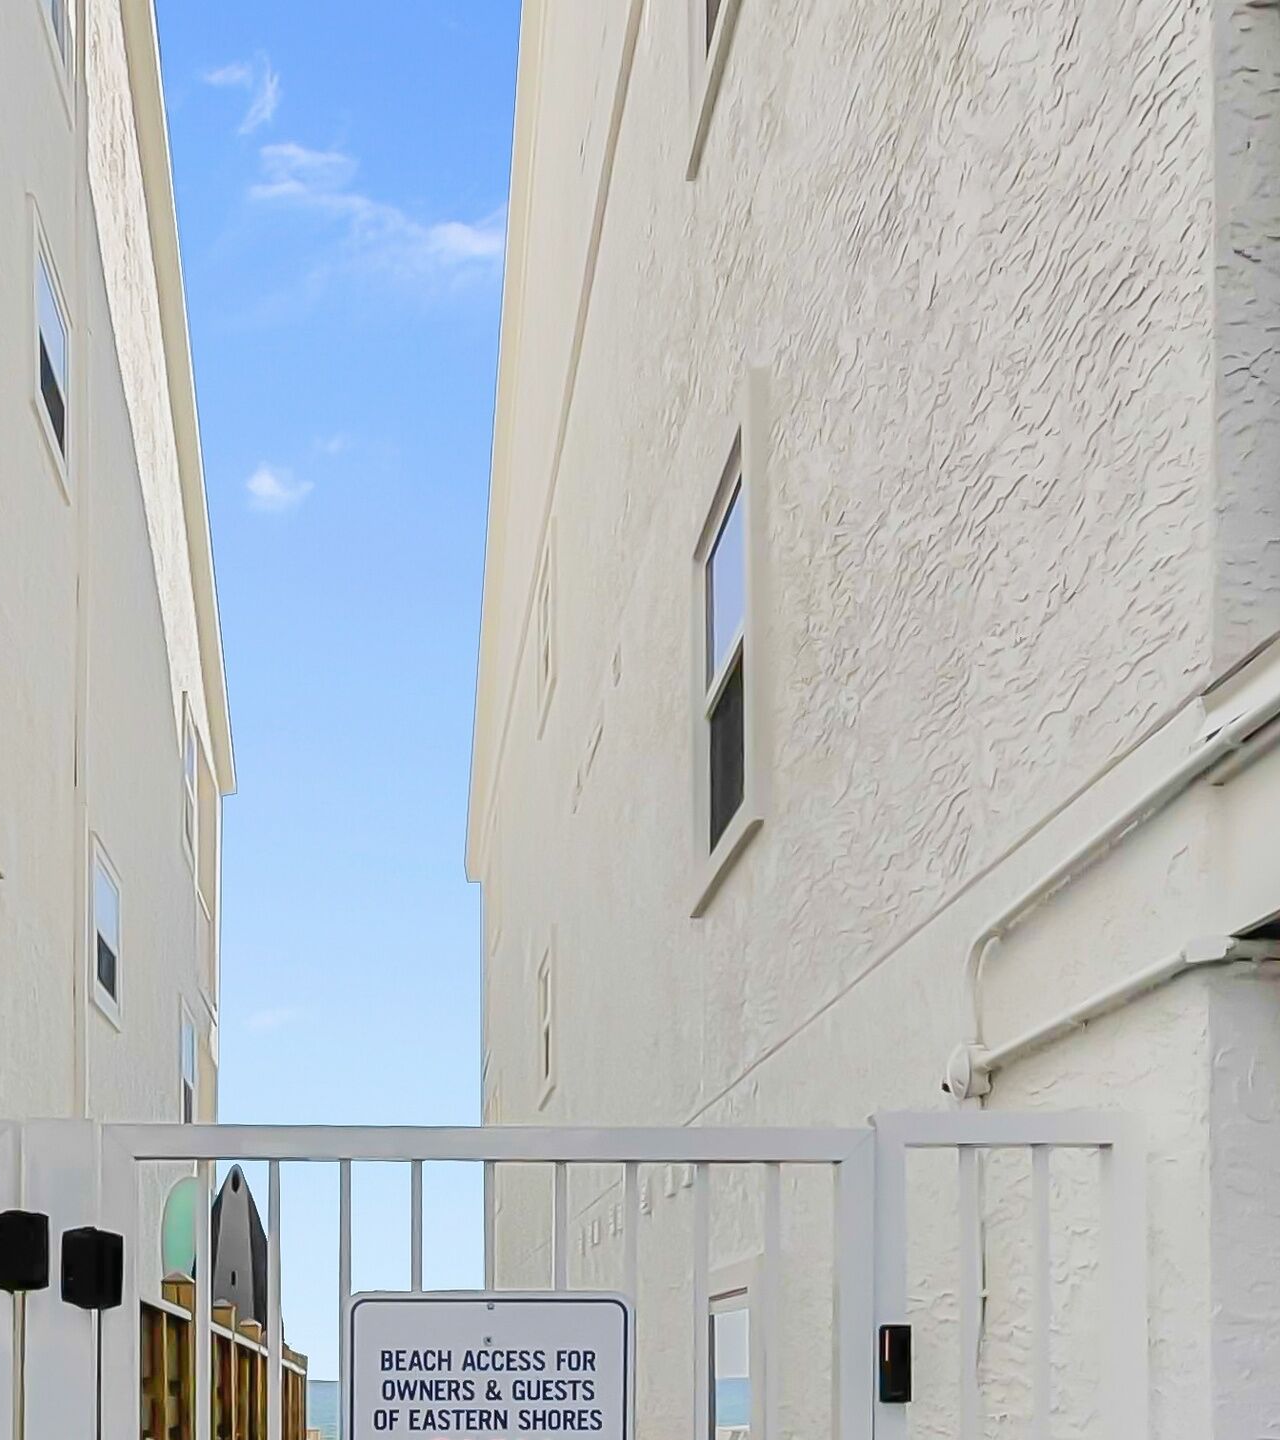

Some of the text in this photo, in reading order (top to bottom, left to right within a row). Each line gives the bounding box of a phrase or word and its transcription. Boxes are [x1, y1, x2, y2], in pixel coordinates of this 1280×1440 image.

[380, 1350, 595, 1371] BEACH ACCESS FOR
[382, 1380, 594, 1400] OWNERS & GUESTS
[374, 1409, 602, 1430] OF EASTERN SHORES
